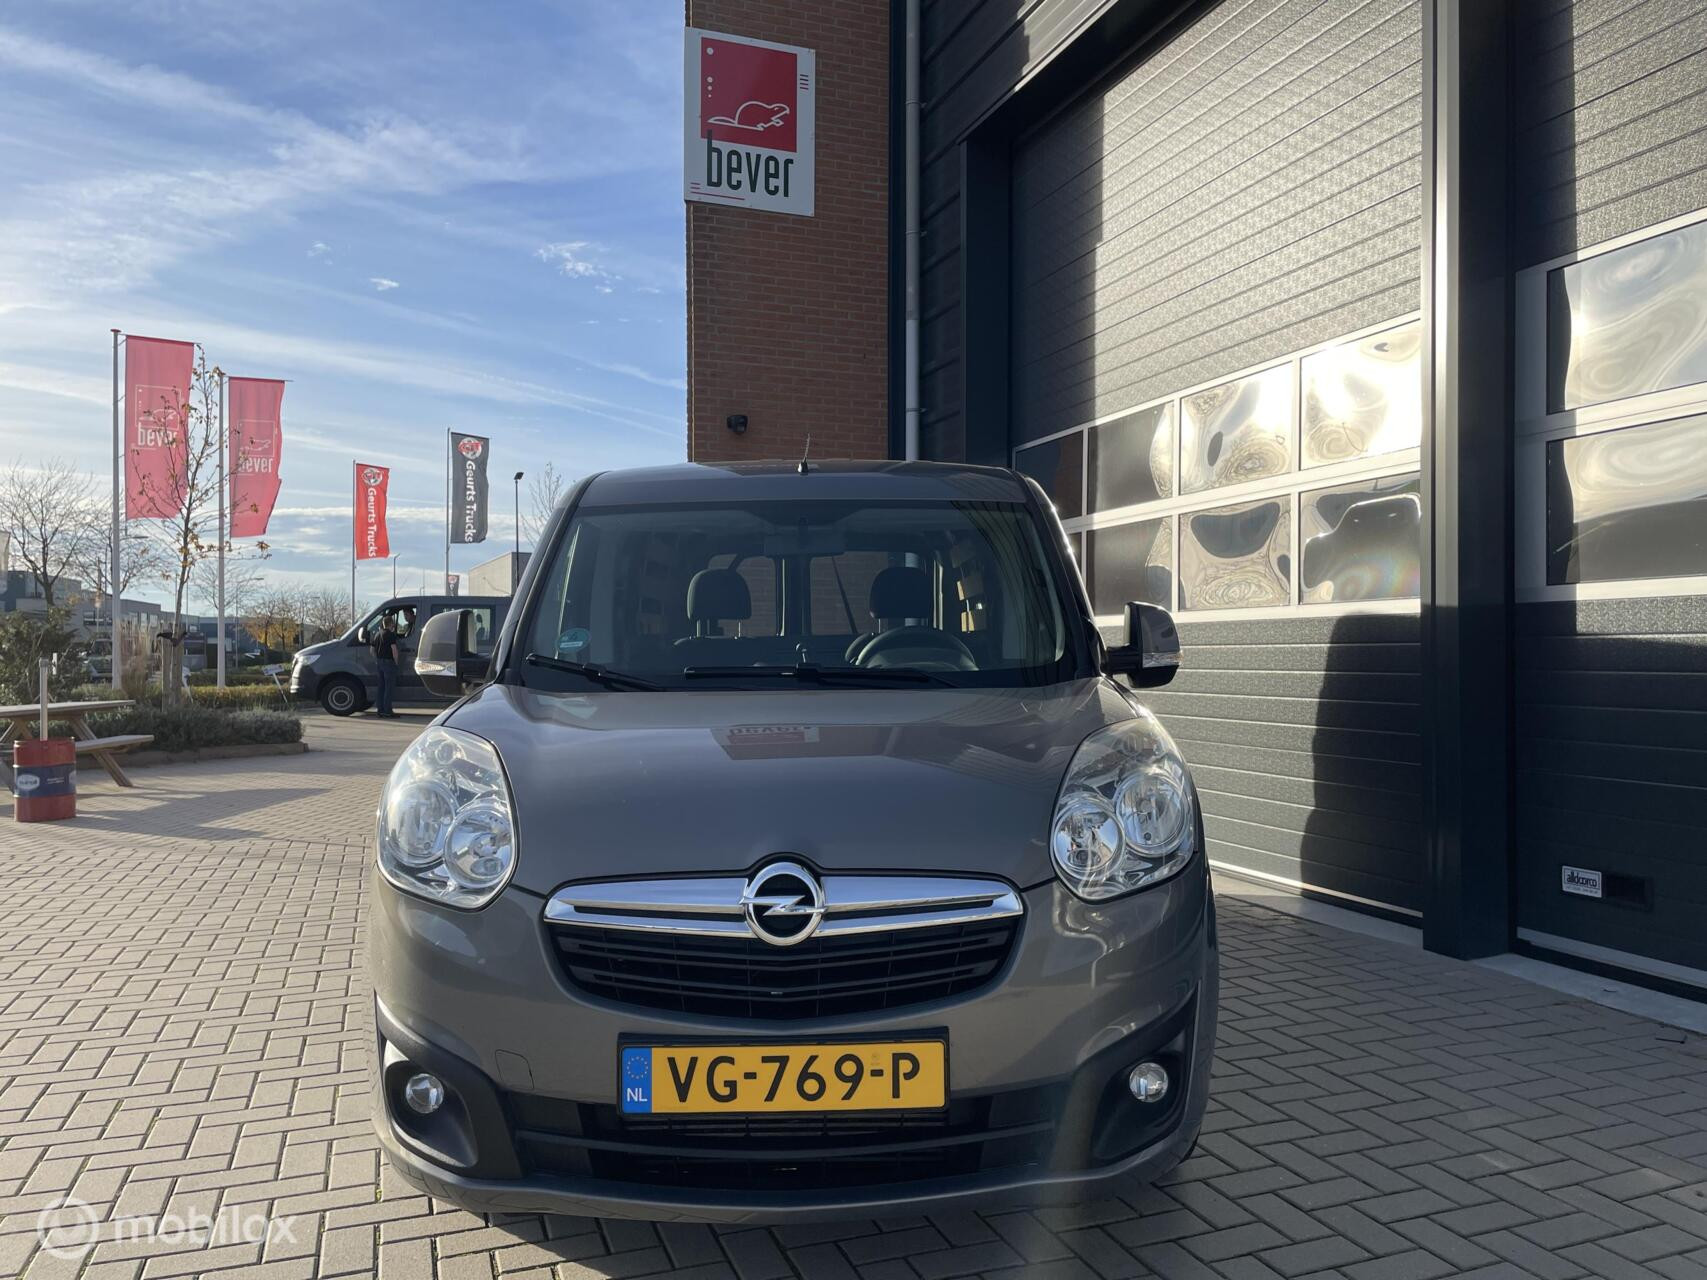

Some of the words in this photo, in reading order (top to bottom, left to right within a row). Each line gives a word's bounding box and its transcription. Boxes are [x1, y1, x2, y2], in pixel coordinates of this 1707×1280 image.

[706, 129, 794, 198] bever
[137, 422, 178, 448] bever
[465, 460, 476, 501] Geurts
[367, 487, 377, 523] Geurts
[464, 503, 477, 542] Trucks
[367, 525, 378, 557] Trucks
[627, 1087, 648, 1102] NL
[667, 1052, 921, 1103] VG-769-P
